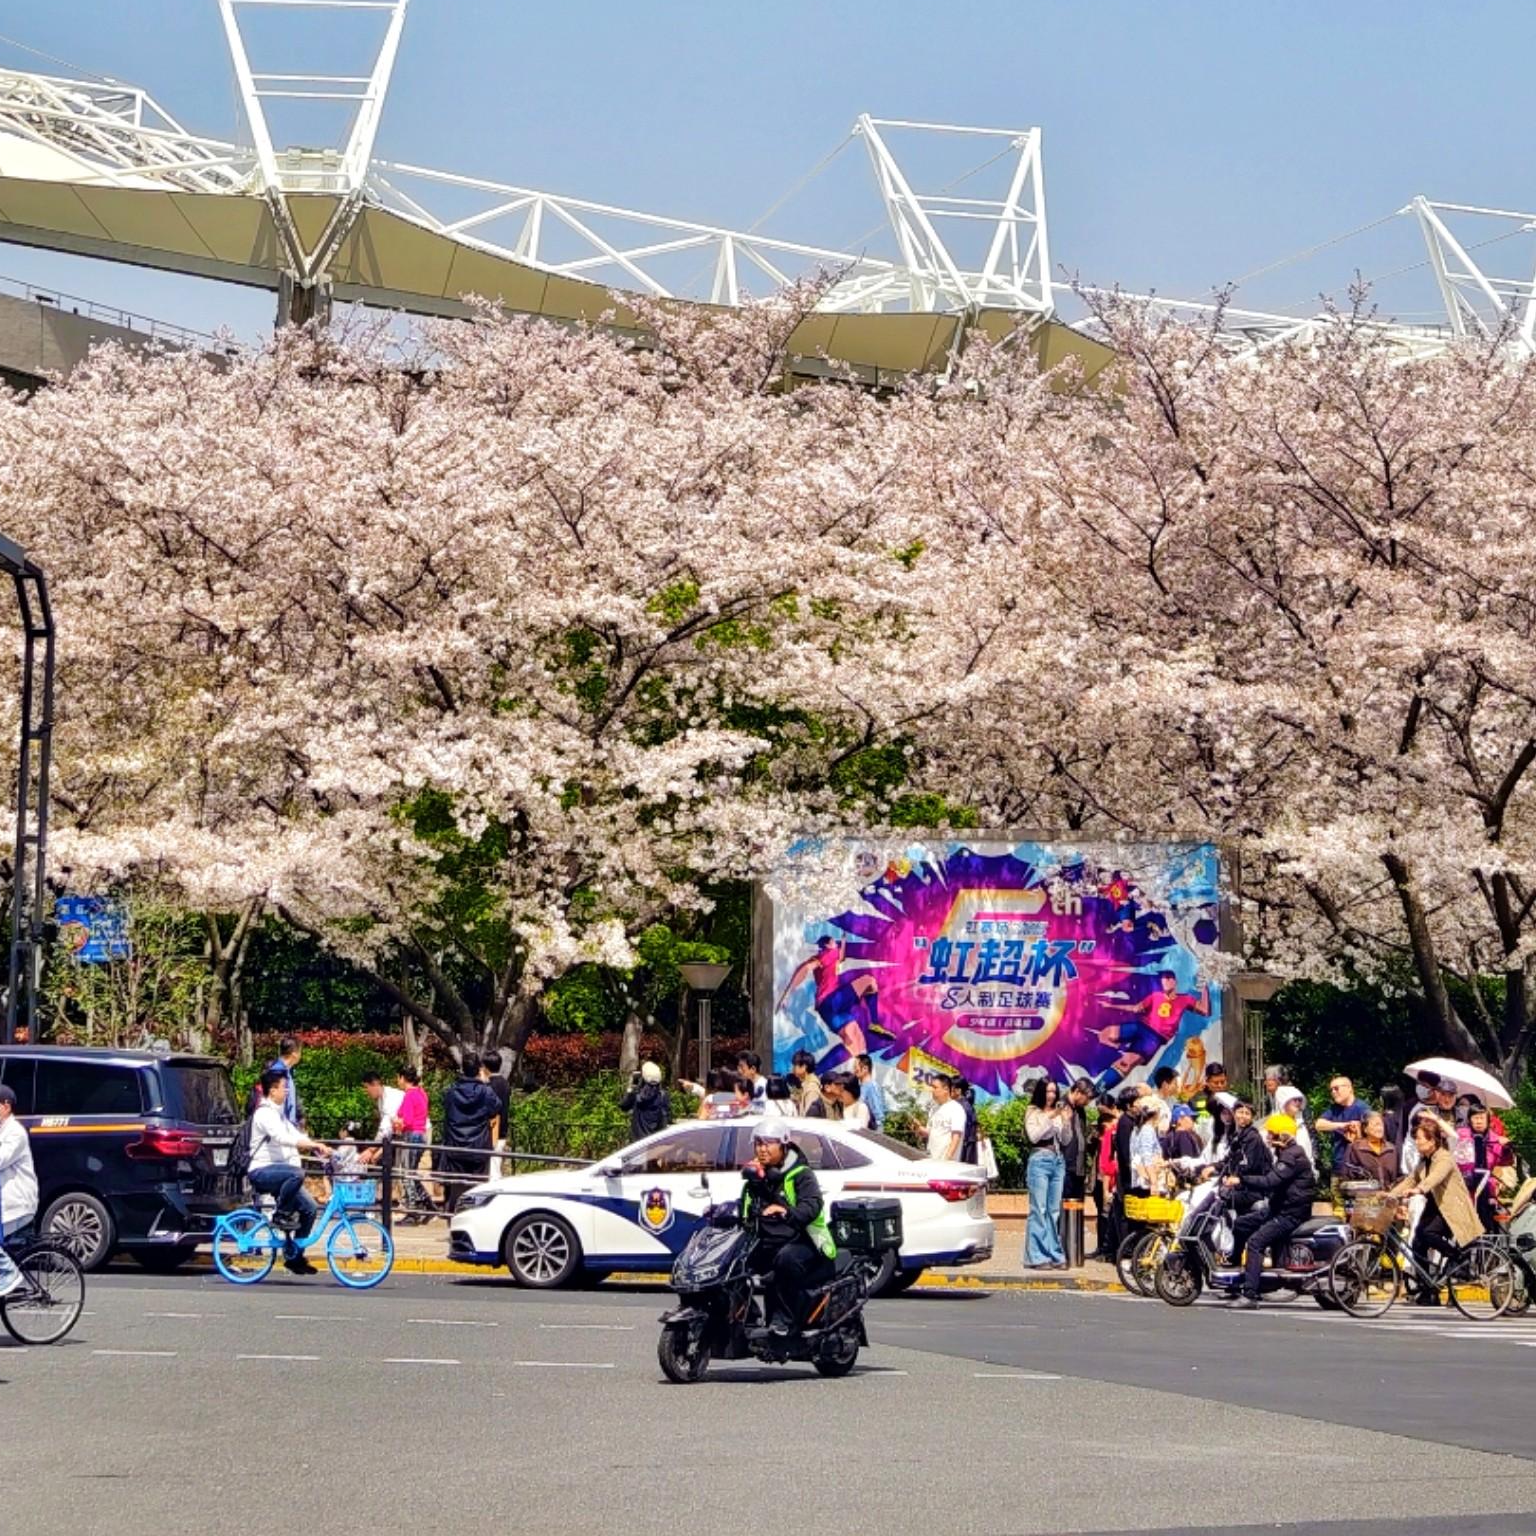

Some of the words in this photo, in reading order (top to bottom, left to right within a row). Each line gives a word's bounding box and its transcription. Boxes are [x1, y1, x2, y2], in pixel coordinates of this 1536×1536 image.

[941, 986, 1052, 1010] 8人制足球赛
[1157, 1002, 1172, 1018] 8
